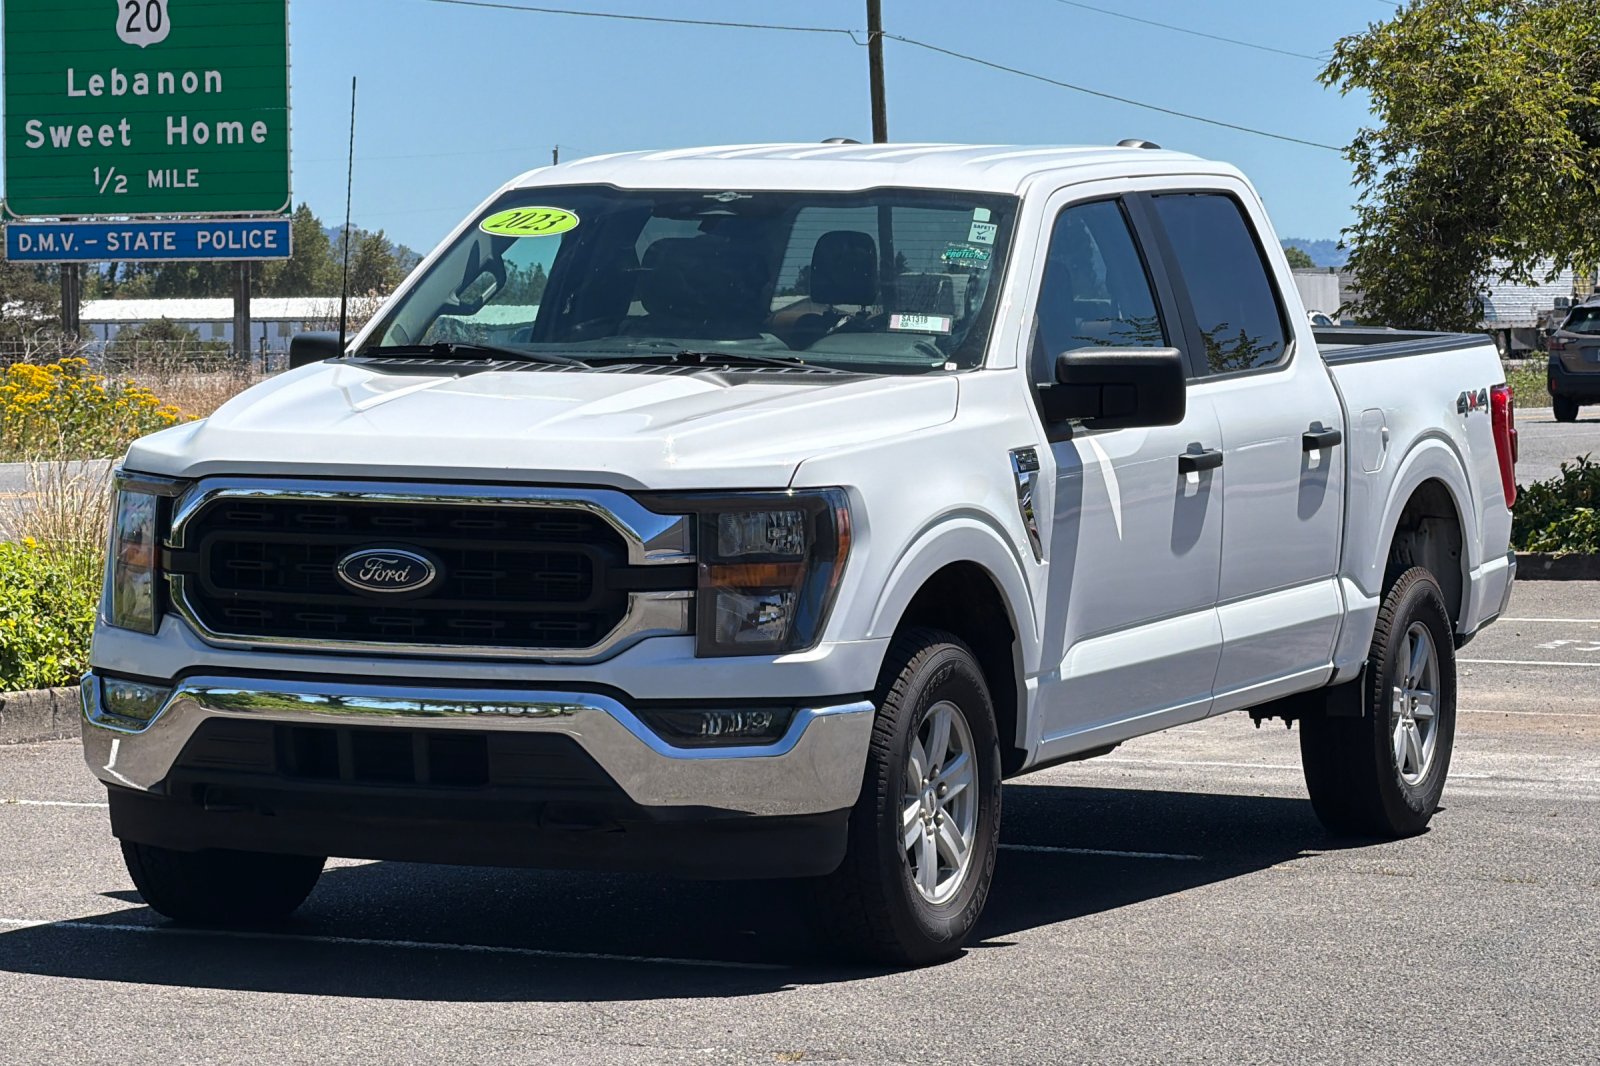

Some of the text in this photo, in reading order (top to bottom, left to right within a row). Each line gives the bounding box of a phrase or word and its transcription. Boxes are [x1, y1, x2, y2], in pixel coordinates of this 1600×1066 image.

[126, 0, 162, 33] 20
[67, 68, 223, 97] Lebanon
[25, 116, 268, 149] Sweet Home
[93, 166, 200, 194] 1/2 MILE
[488, 212, 568, 231] 2023
[107, 231, 176, 250] STATE
[197, 229, 277, 249] POLICE
[360, 557, 411, 582] Ford
